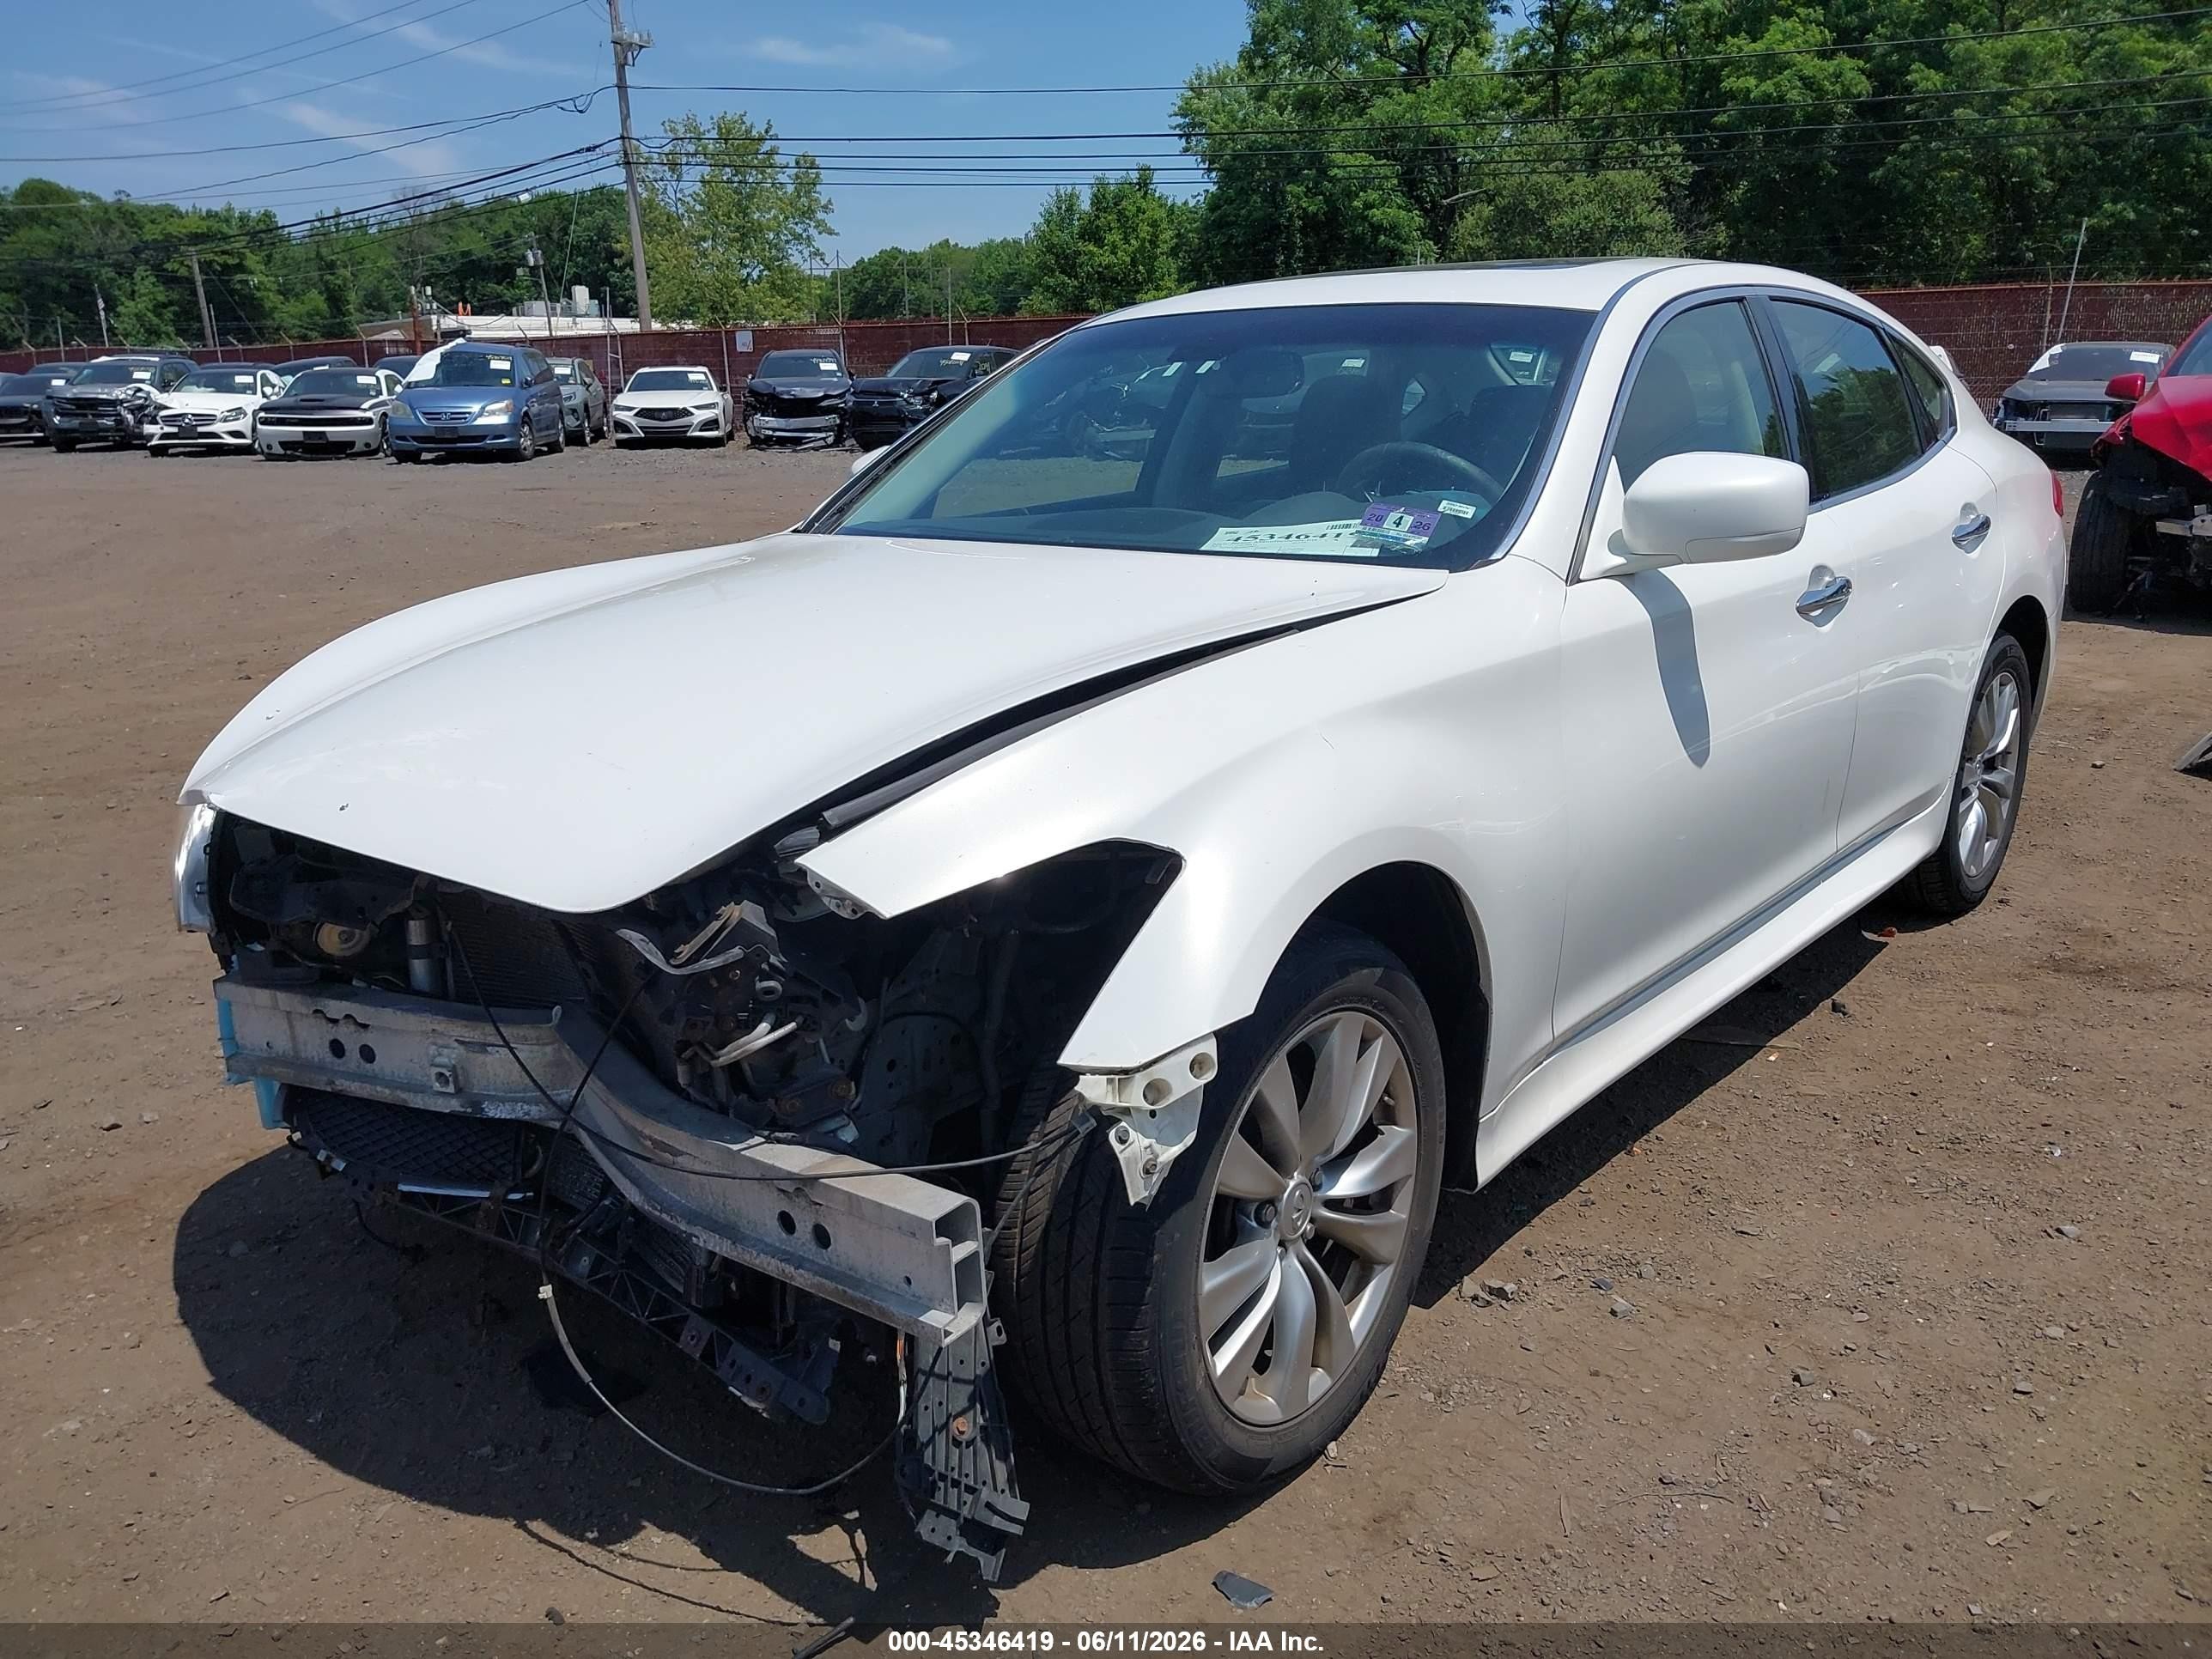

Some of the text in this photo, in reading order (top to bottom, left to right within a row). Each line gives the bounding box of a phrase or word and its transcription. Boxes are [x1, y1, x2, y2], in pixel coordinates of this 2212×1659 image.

[1366, 513, 1431, 531] 20 4 26
[1226, 532, 1358, 542] 4534641
